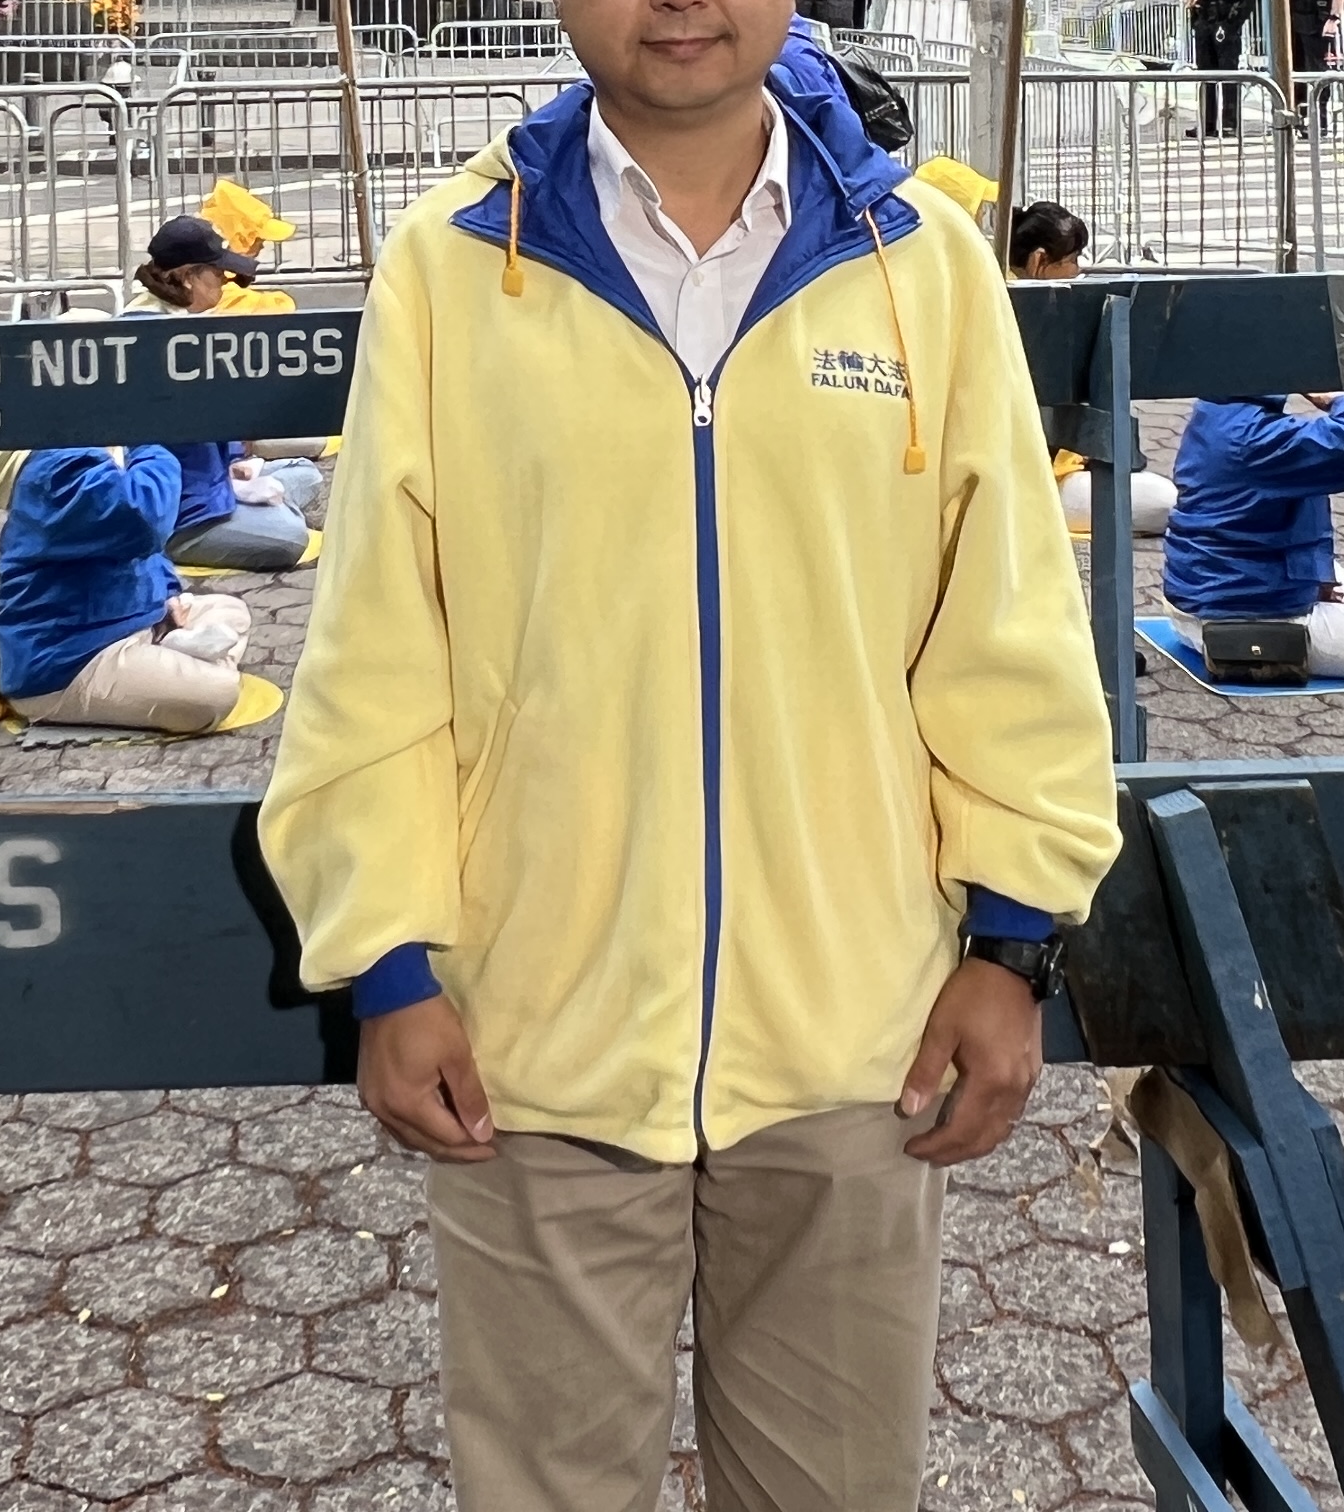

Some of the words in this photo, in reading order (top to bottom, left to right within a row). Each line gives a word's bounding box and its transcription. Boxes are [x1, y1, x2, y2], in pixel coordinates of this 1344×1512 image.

[29, 335, 138, 388] NOT
[166, 327, 344, 382] CROSS
[811, 373, 869, 392] FALUN
[874, 378, 910, 400] DAFA
